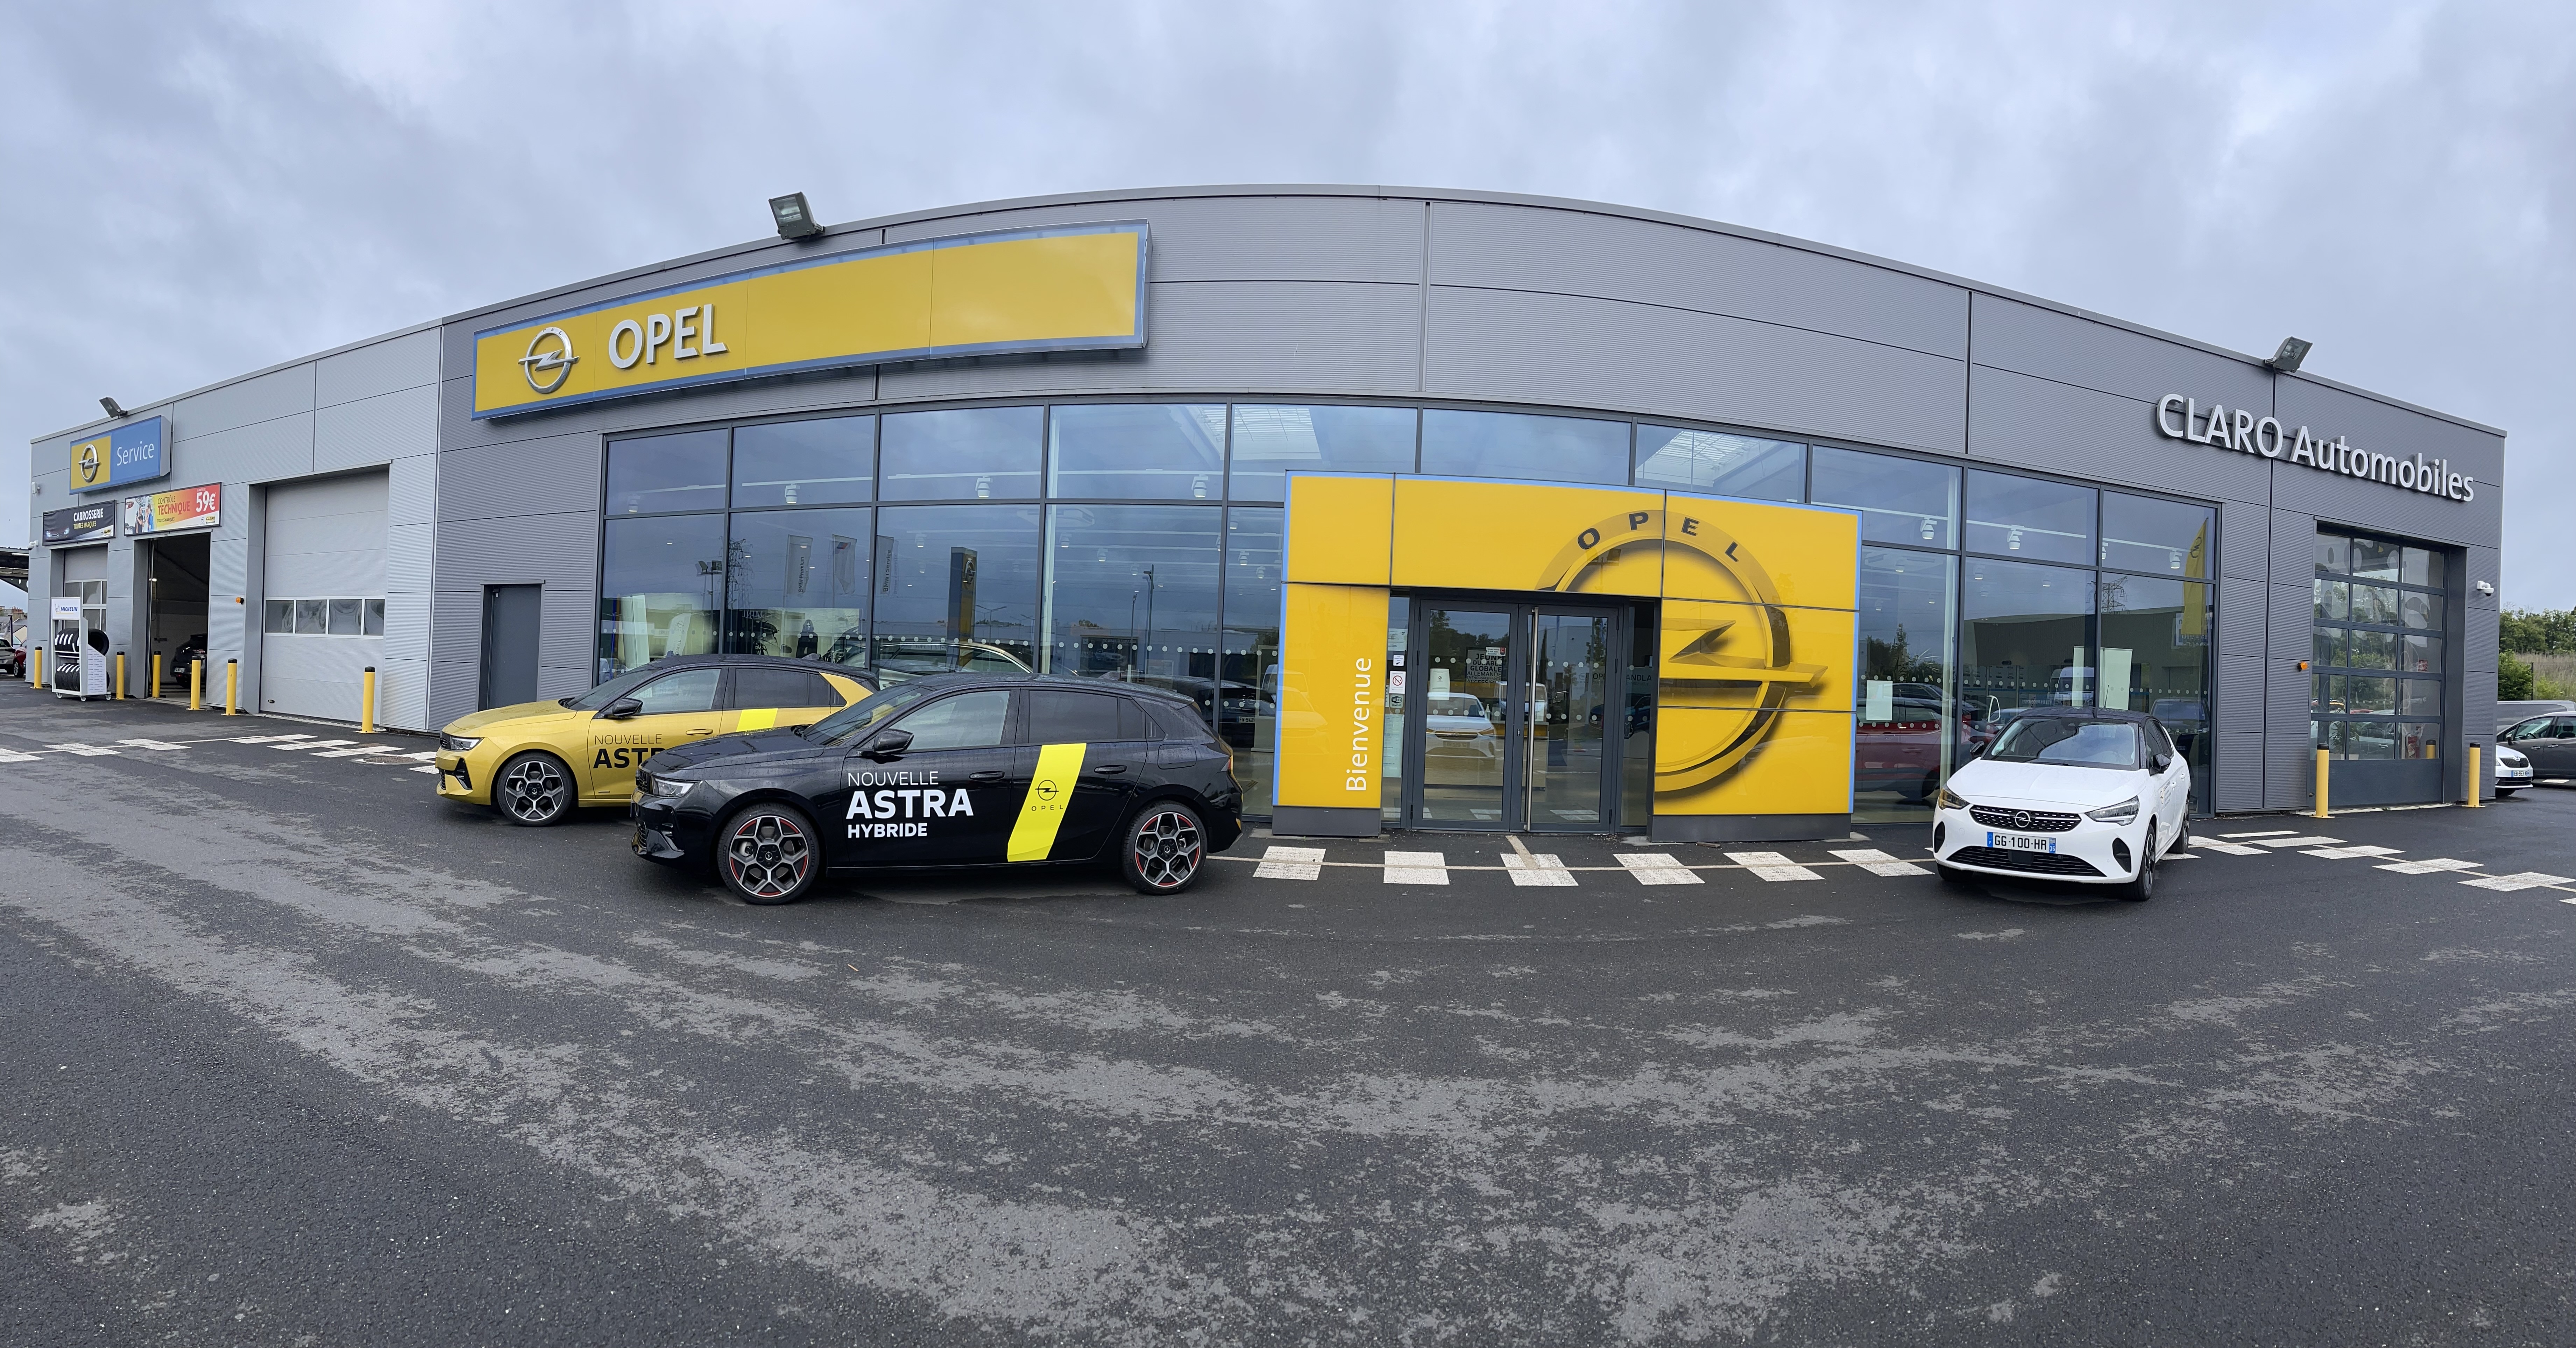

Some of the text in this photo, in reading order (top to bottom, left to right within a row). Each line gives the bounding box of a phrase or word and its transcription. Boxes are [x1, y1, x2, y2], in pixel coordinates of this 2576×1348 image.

[609, 304, 729, 368] OPEL
[117, 441, 154, 466] Service
[2157, 394, 2474, 502] CLARO Automobiles
[158, 495, 176, 505] CONTRÔLE
[73, 508, 104, 522] CARROSSERIE
[158, 501, 190, 515] TECHNIQUE
[84, 520, 97, 528] MARQUES
[1577, 512, 1739, 562] OPEL
[1346, 658, 1371, 791] Bienvenue
[595, 734, 662, 745] NOUVELLE
[848, 771, 939, 786] NOUVELLE
[846, 789, 974, 819] ASTRA
[848, 823, 927, 838] HYBRIDE
[1995, 835, 2047, 850] GG-100-HR
